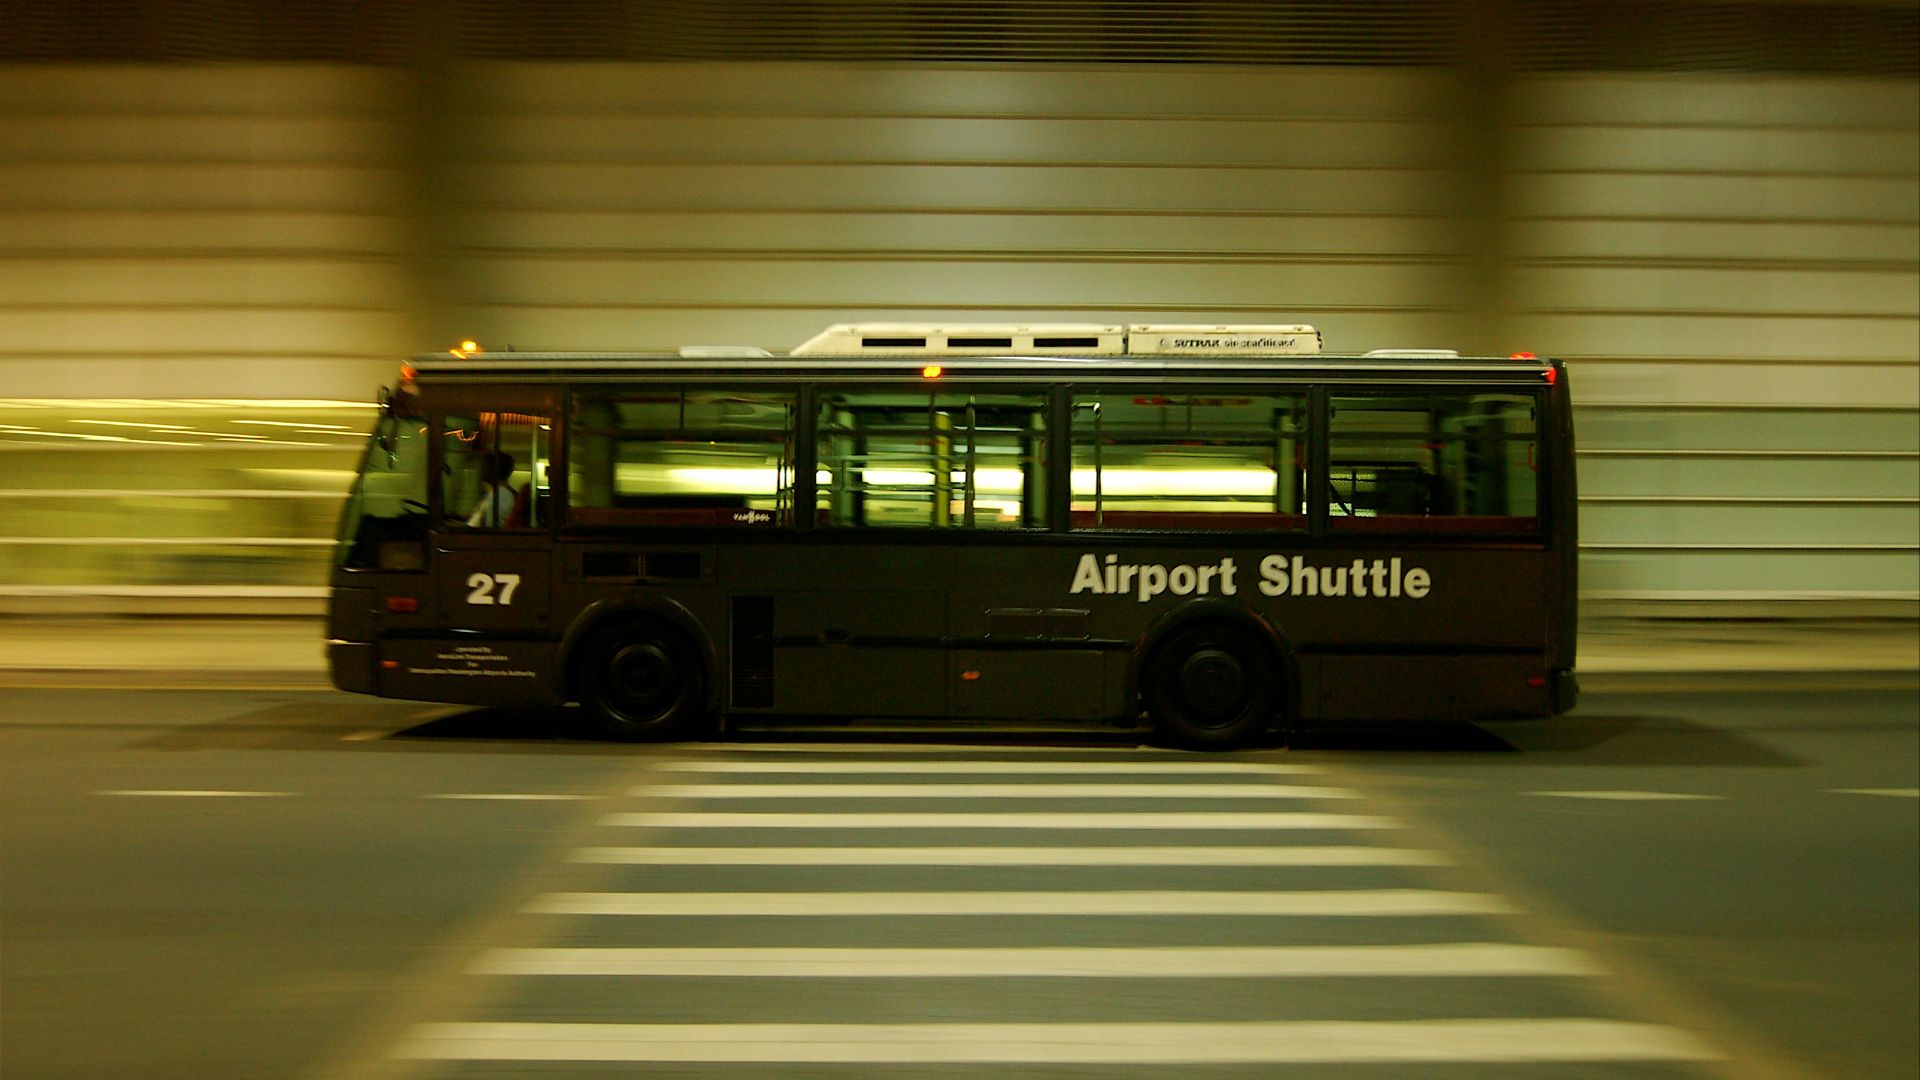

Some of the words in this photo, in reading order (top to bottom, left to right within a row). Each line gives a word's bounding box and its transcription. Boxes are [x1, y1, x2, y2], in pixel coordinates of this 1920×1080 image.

[467, 572, 520, 605] 27
[1070, 554, 1237, 602] Airport
[1258, 555, 1432, 599] Shuttle
